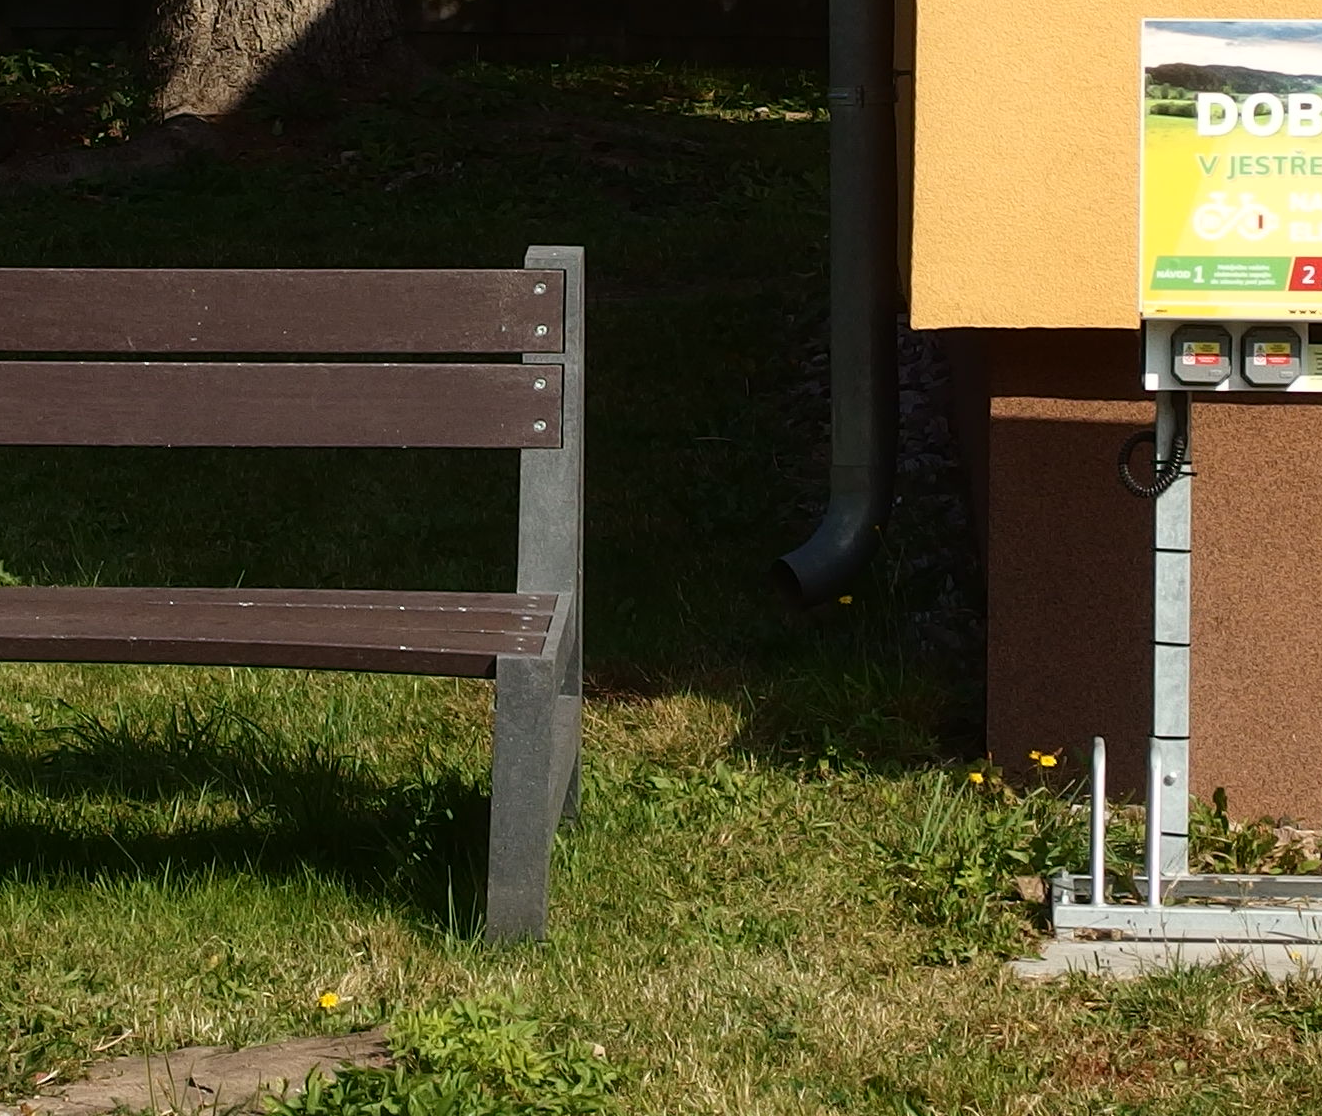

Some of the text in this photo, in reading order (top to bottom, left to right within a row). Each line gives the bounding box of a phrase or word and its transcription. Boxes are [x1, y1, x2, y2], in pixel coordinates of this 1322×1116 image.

[1198, 155, 1218, 175] V
[1156, 269, 1191, 279] NÁVOD
[1193, 265, 1205, 283] 1
[1302, 265, 1315, 284] 2
